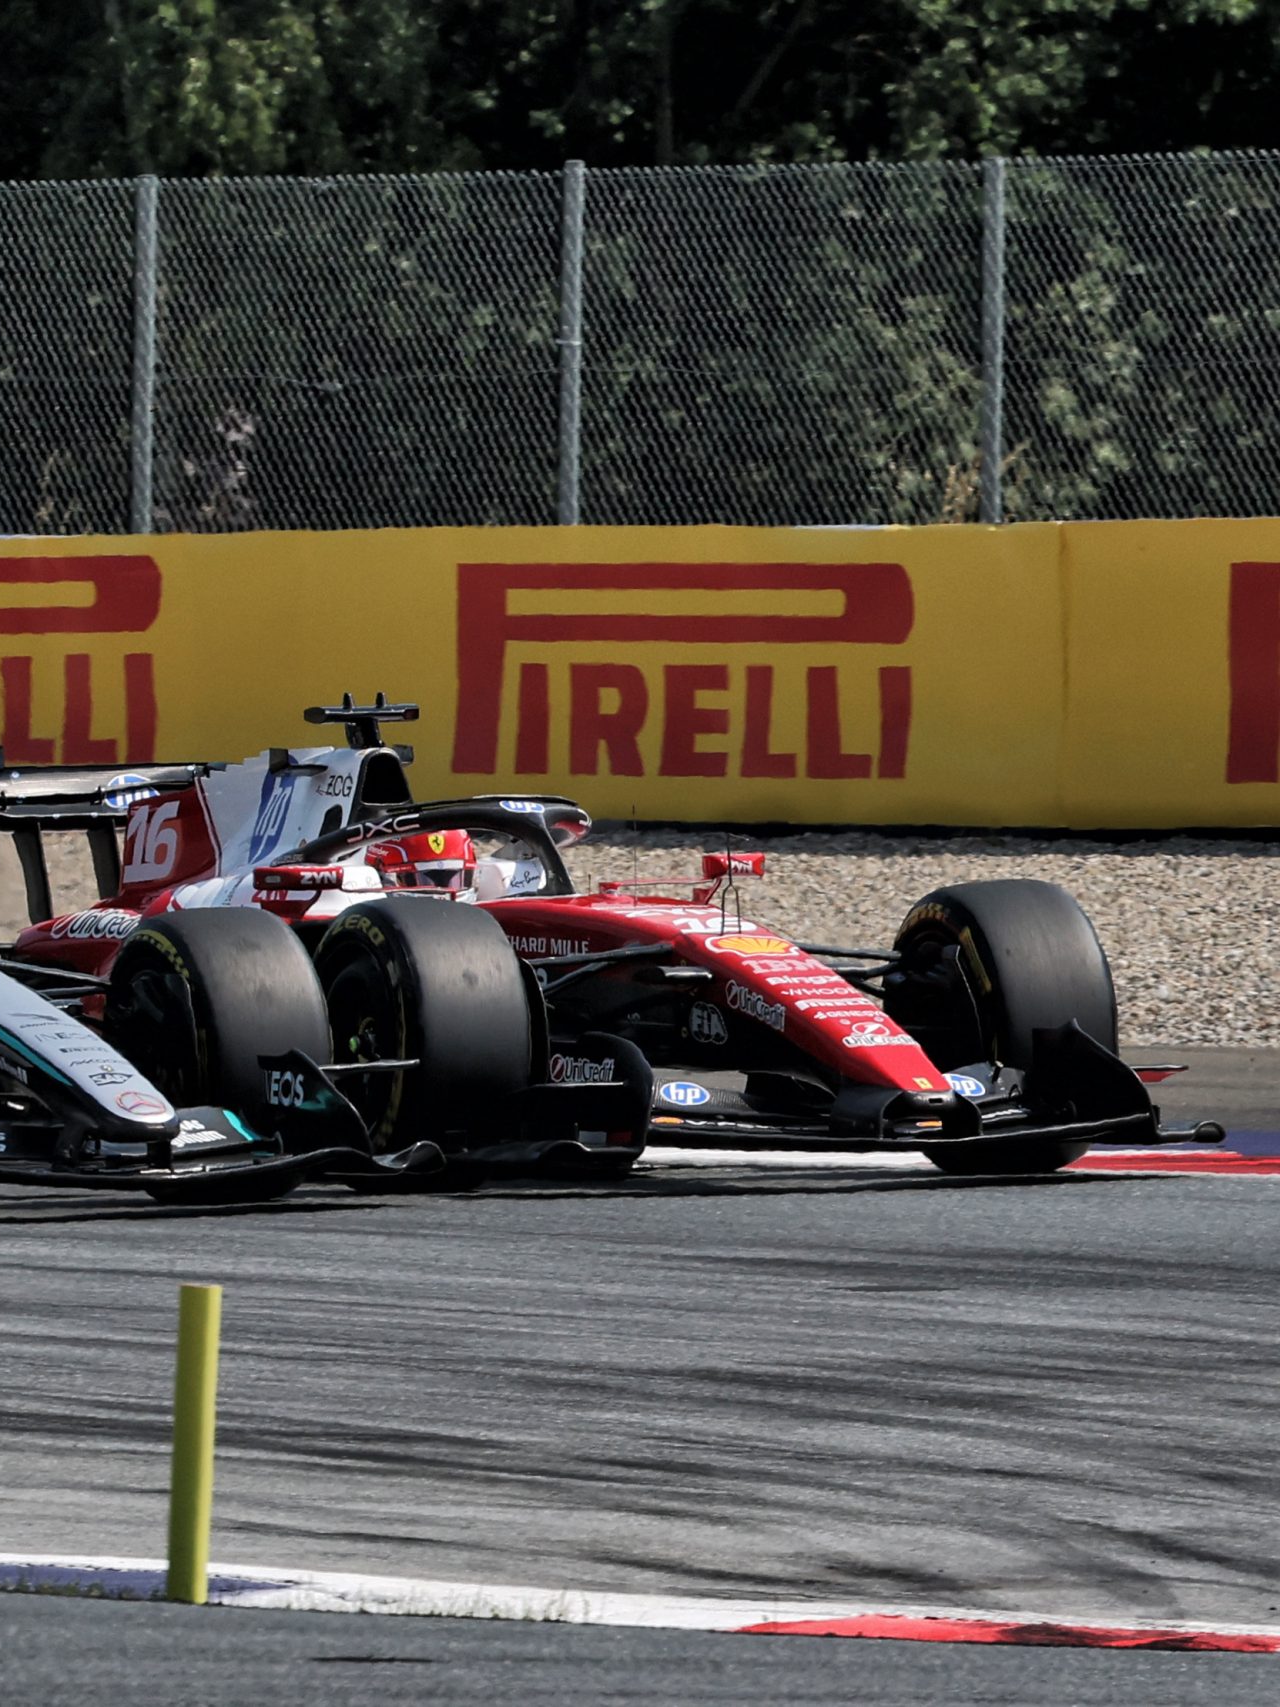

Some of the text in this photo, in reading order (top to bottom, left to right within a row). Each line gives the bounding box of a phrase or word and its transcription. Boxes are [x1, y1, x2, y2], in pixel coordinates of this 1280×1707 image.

[452, 563, 915, 779] PIRELLI
[123, 800, 180, 883] 16
[300, 871, 337, 885] ZYN
[742, 959, 831, 974] IBM
[692, 1008, 723, 1036] FIA
[564, 1056, 615, 1083] UniCredit
[669, 1082, 701, 1104] hp
